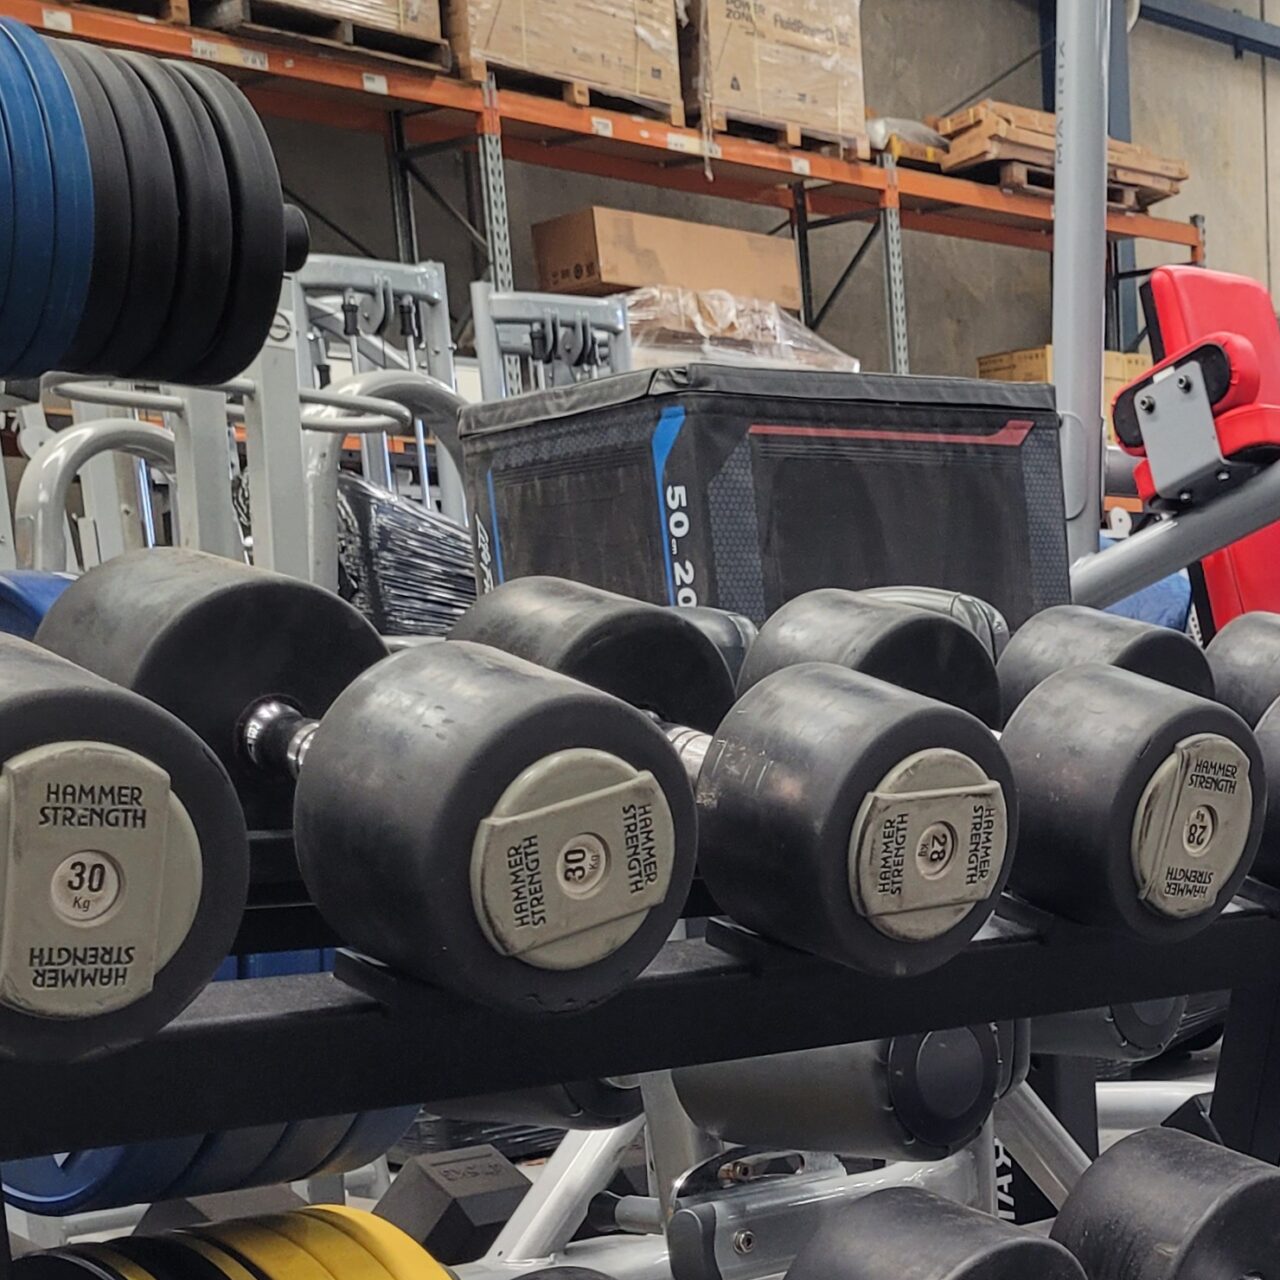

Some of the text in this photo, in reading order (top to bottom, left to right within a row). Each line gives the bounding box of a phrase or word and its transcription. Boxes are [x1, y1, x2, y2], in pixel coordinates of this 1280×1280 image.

[1188, 774, 1237, 794] STRENGTH
[1194, 760, 1238, 779] HAMMER
[47, 783, 143, 806] HAMMER
[39, 806, 147, 829] STRENGTH
[638, 803, 658, 885] HAMMER
[930, 833, 947, 862] 28
[966, 805, 984, 885] STRENGTH
[978, 807, 995, 880] HAMMER
[1188, 823, 1207, 846] 28
[622, 804, 644, 895] STRENGTH
[878, 818, 896, 894] HAMMER
[891, 813, 909, 895] STRENGTH
[67, 861, 106, 892] 30
[564, 848, 586, 882] 30
[1165, 866, 1213, 884] STRENGTH
[507, 844, 530, 929] HAMMER
[523, 834, 546, 927] STRENGTH
[1164, 882, 1208, 898] HAMMER
[72, 897, 91, 912] Kg
[29, 946, 135, 967] STRENGTH
[32, 967, 127, 988] HAMMER
